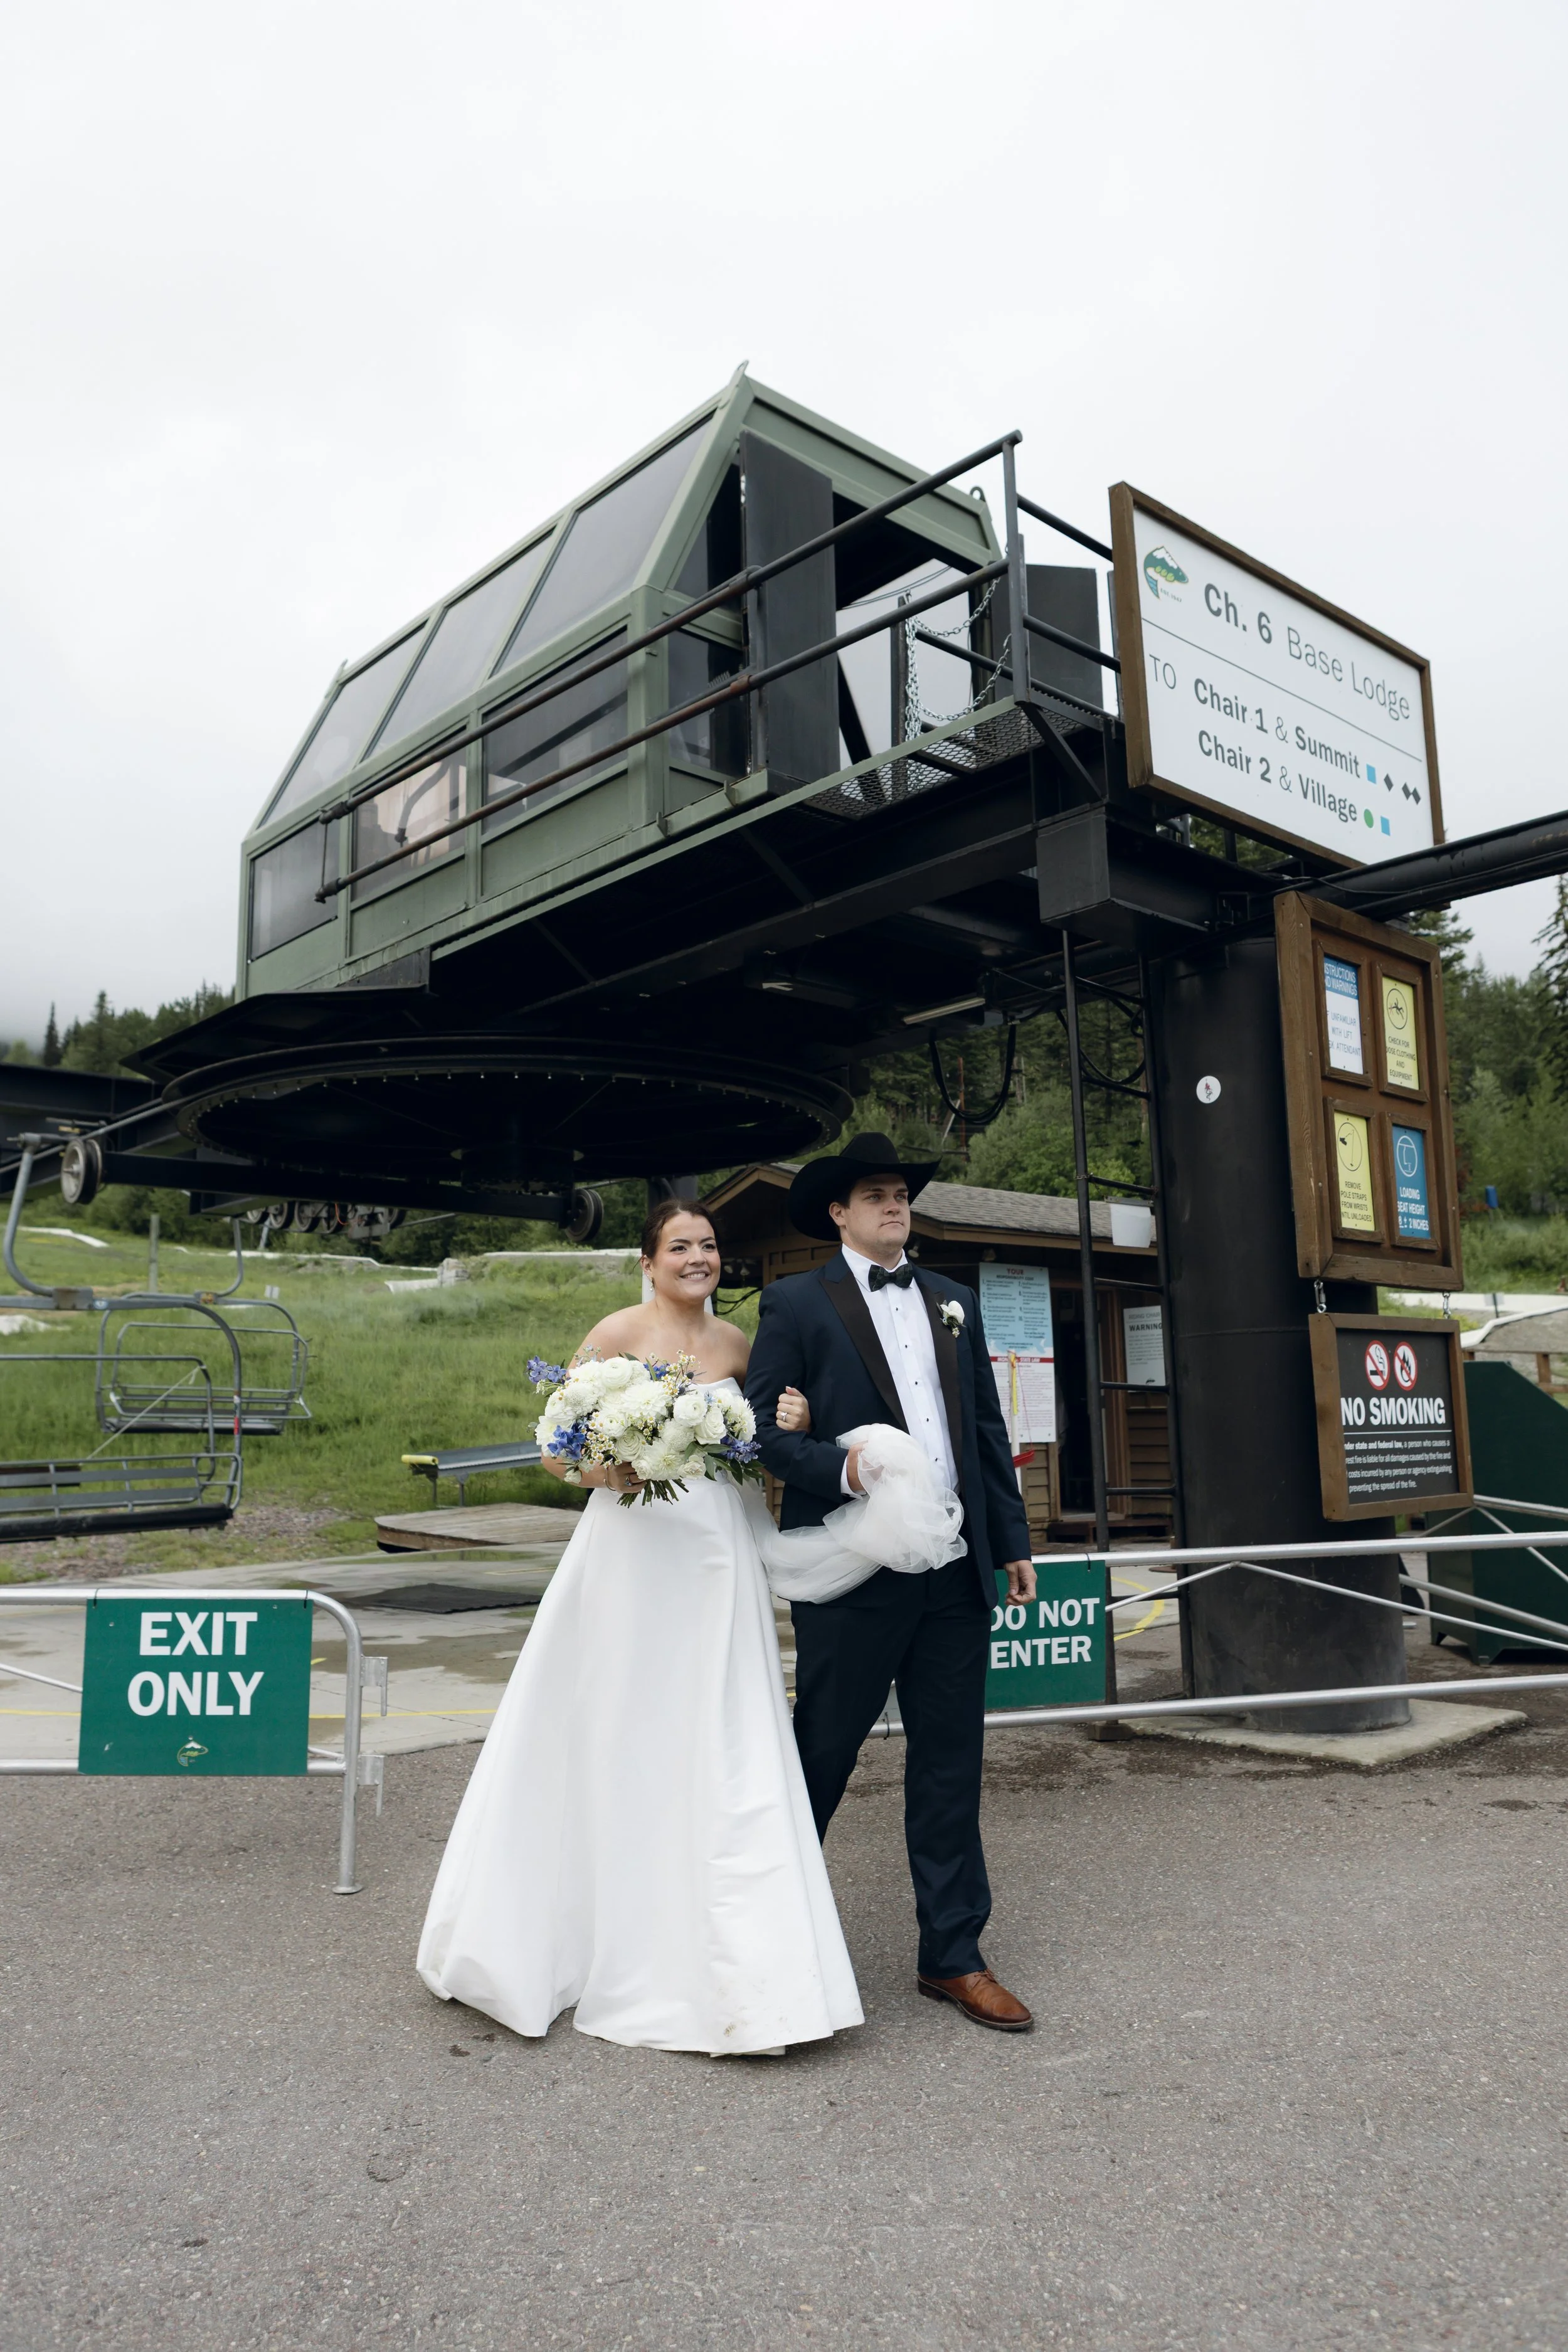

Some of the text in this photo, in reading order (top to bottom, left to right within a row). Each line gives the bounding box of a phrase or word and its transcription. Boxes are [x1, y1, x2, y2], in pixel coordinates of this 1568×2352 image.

[1204, 583, 1410, 721] Ch. 6 Base Lodge
[1149, 654, 1177, 689] TO
[1194, 678, 1360, 778] Chair 1 & Summit
[1199, 730, 1357, 823] Chair 2 & Village
[1324, 963, 1356, 983] STRUCTIONS
[1332, 978, 1357, 997] WARNINGS
[1332, 1013, 1357, 1027] UNFAMILIAR
[1332, 1026, 1352, 1040] WITH LIFT
[1388, 1036, 1410, 1048] CHECK FOR
[1336, 1042, 1361, 1057] ATTENDANT
[1396, 1049, 1416, 1061] CLOTHING
[1396, 1060, 1405, 1068] AND
[1390, 1069, 1412, 1081] EQUIPMENT
[1345, 1181, 1361, 1190] REMOVE
[1340, 1190, 1367, 1201] POLE STRAPS
[1399, 1187, 1420, 1200] LOADING
[1353, 1203, 1368, 1211] WRISTS
[1397, 1201, 1425, 1216] SEAT HEIGHT
[1350, 1212, 1372, 1222] UNLOADED
[1409, 1217, 1412, 1229] 2
[1412, 1218, 1429, 1231] INCHES
[1340, 1397, 1446, 1426] NO SMOKING
[1344, 1441, 1354, 1450] nder
[1355, 1441, 1367, 1449] state
[1368, 1441, 1377, 1449] and
[1377, 1440, 1394, 1449] federal
[1407, 1441, 1422, 1449] person
[1354, 1455, 1362, 1464] fire
[1362, 1455, 1367, 1463] is
[1367, 1454, 1379, 1463] liable
[1391, 1454, 1409, 1463] damages
[1409, 1453, 1424, 1461] caused
[1424, 1453, 1429, 1461] by
[1348, 1470, 1360, 1478] costs
[1360, 1469, 1379, 1477] incurred
[1379, 1468, 1384, 1478] by
[1384, 1469, 1392, 1477] any
[1392, 1468, 1407, 1476] person
[1412, 1467, 1427, 1476] agency
[1427, 1465, 1453, 1475] extinguishing
[1349, 1483, 1372, 1494] preventing
[1380, 1481, 1395, 1491] spread
[1396, 1480, 1401, 1489] of
[1039, 1597, 1099, 1628] NOT
[139, 1612, 258, 1656] EXIT
[990, 1635, 1092, 1669] ENTER
[127, 1671, 265, 1717] ONLY
